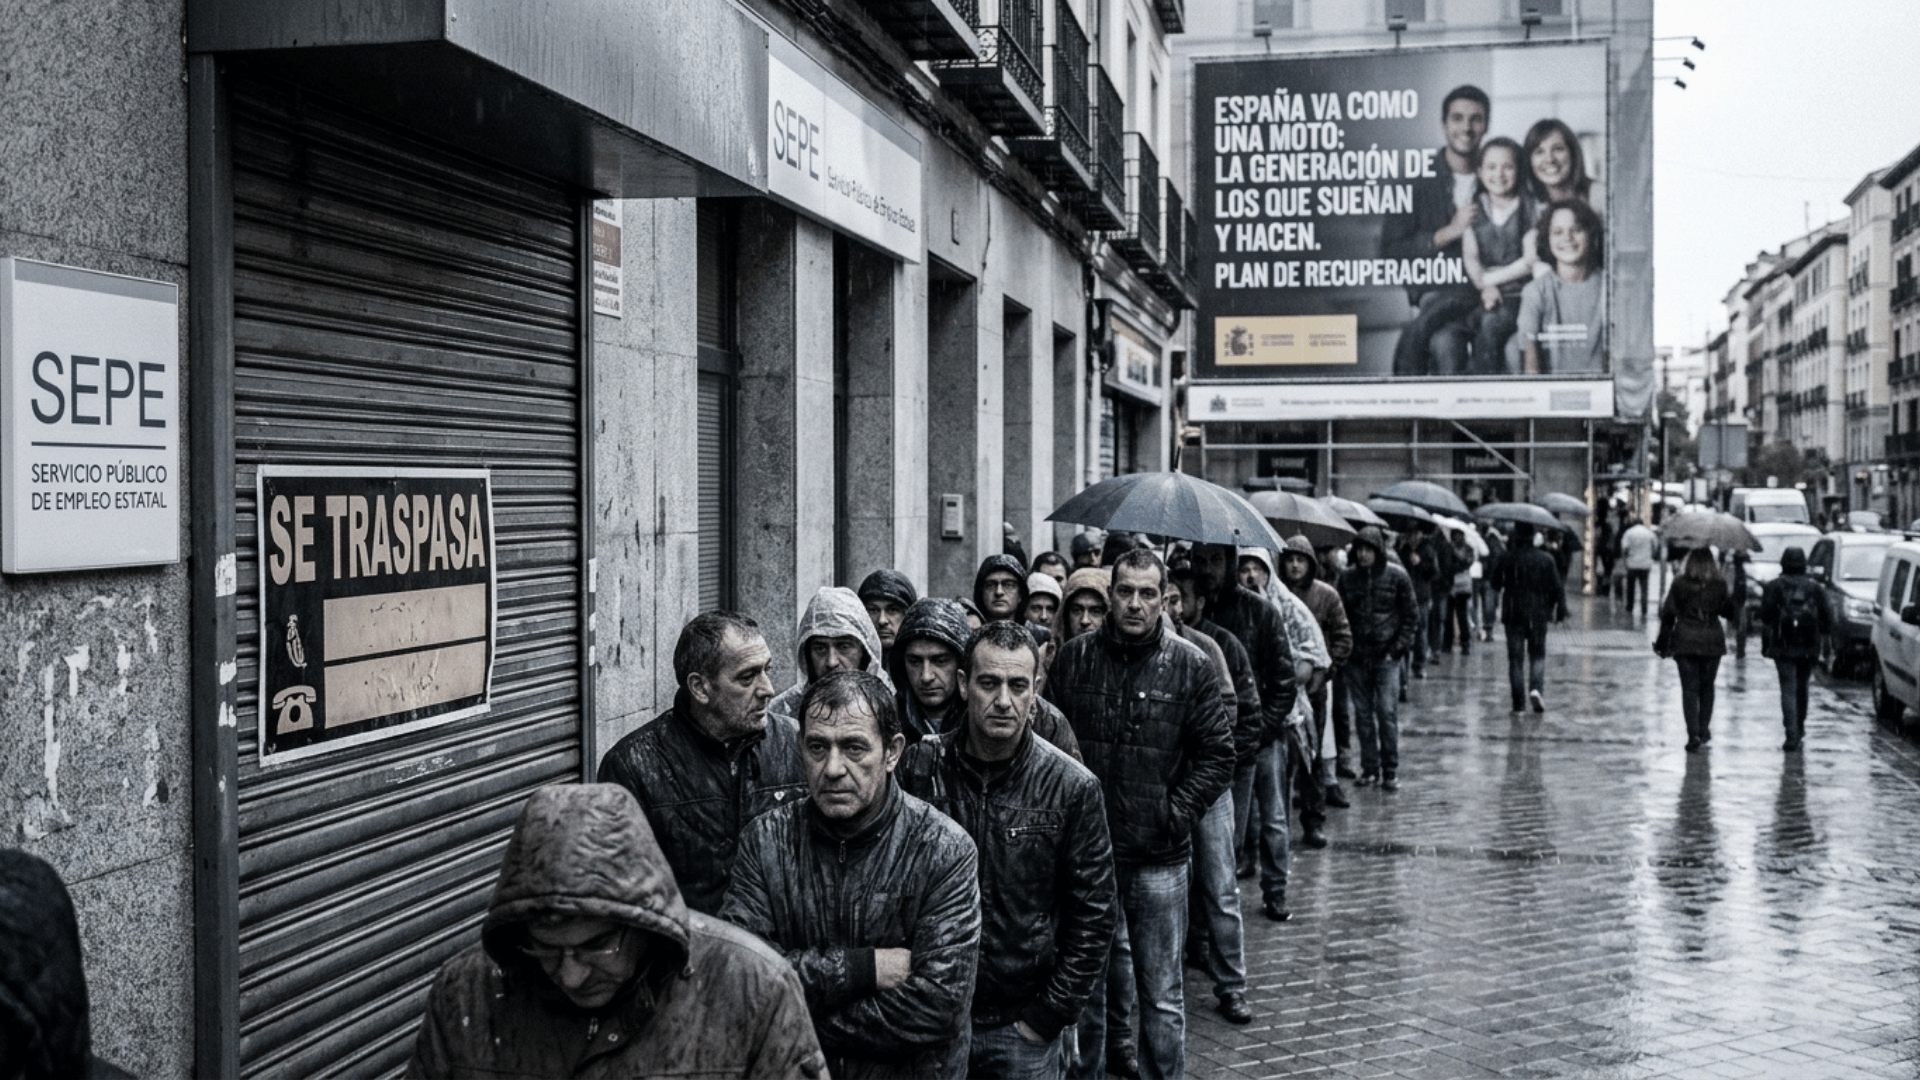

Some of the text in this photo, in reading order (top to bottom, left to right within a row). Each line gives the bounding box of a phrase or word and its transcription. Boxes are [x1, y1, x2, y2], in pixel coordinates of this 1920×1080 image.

[1214, 87, 1418, 124] ESPAÑA VA COMO
[774, 99, 819, 181] SEPE
[1215, 121, 1344, 153] UNA MOTO:
[1215, 143, 1437, 184] LA GENERACIÓN DE
[1215, 180, 1413, 218] LOS QUE SUEÑAN
[1215, 222, 1321, 252] Y HACEN.
[1215, 252, 1468, 289] PLAN DE RECUPERACIÓN.
[31, 351, 166, 428] SEPE
[31, 460, 167, 483] SERVICIO PÚBLICO
[31, 491, 167, 511] DE EMPLEO ESTATAL
[269, 493, 485, 585] SE TRASPASA
